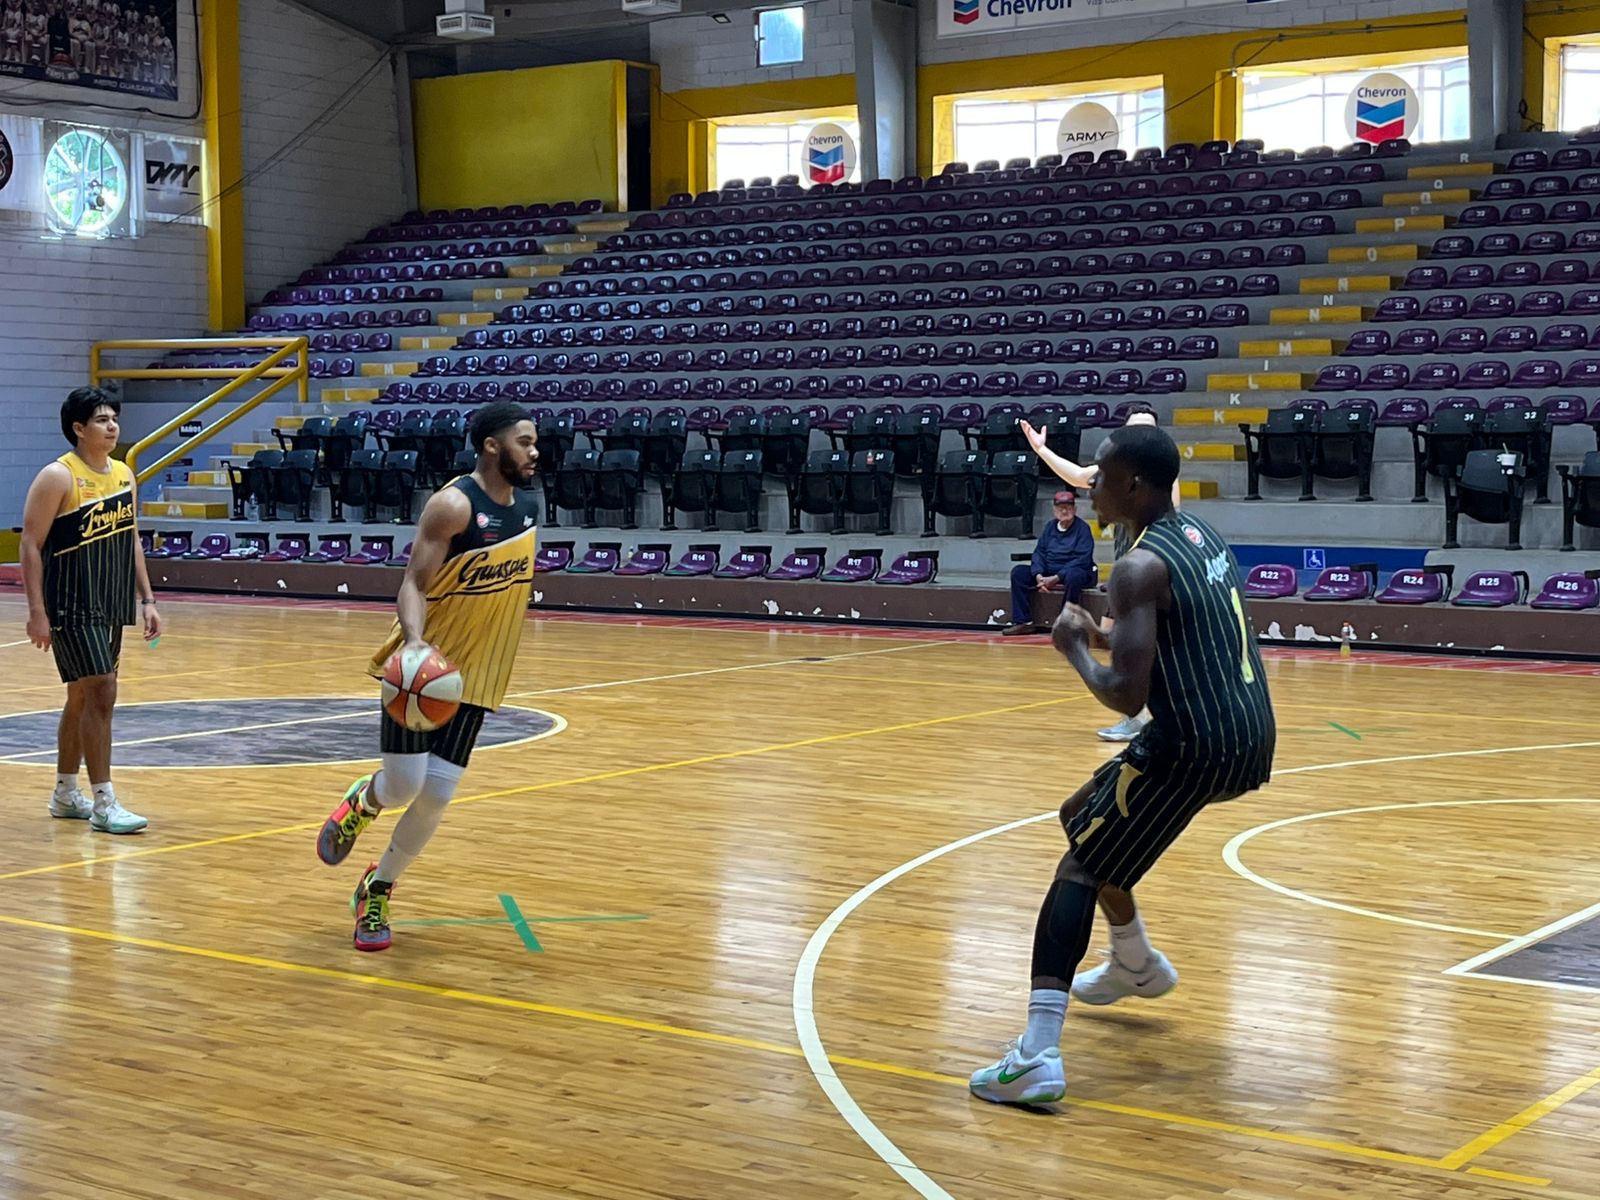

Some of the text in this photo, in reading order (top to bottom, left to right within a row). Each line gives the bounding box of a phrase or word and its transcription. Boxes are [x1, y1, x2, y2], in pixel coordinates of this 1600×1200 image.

[1357, 86, 1406, 98] Chevron
[809, 135, 843, 146] Chevron
[1061, 131, 1115, 142] ARMY
[1460, 154, 1469, 163] R
[1394, 218, 1405, 232] P
[1322, 294, 1333, 306] N
[1309, 308, 1320, 322] N
[1279, 342, 1292, 356] M
[1248, 374, 1258, 390] L
[1230, 394, 1240, 404] K
[1214, 410, 1224, 424] K
[1524, 411, 1537, 420] 32
[847, 558, 862, 566] R17
[1260, 570, 1279, 580] R22
[1330, 573, 1350, 582] R23
[1403, 575, 1423, 585] R24
[1479, 577, 1500, 586] R25
[1557, 581, 1578, 591] R26
